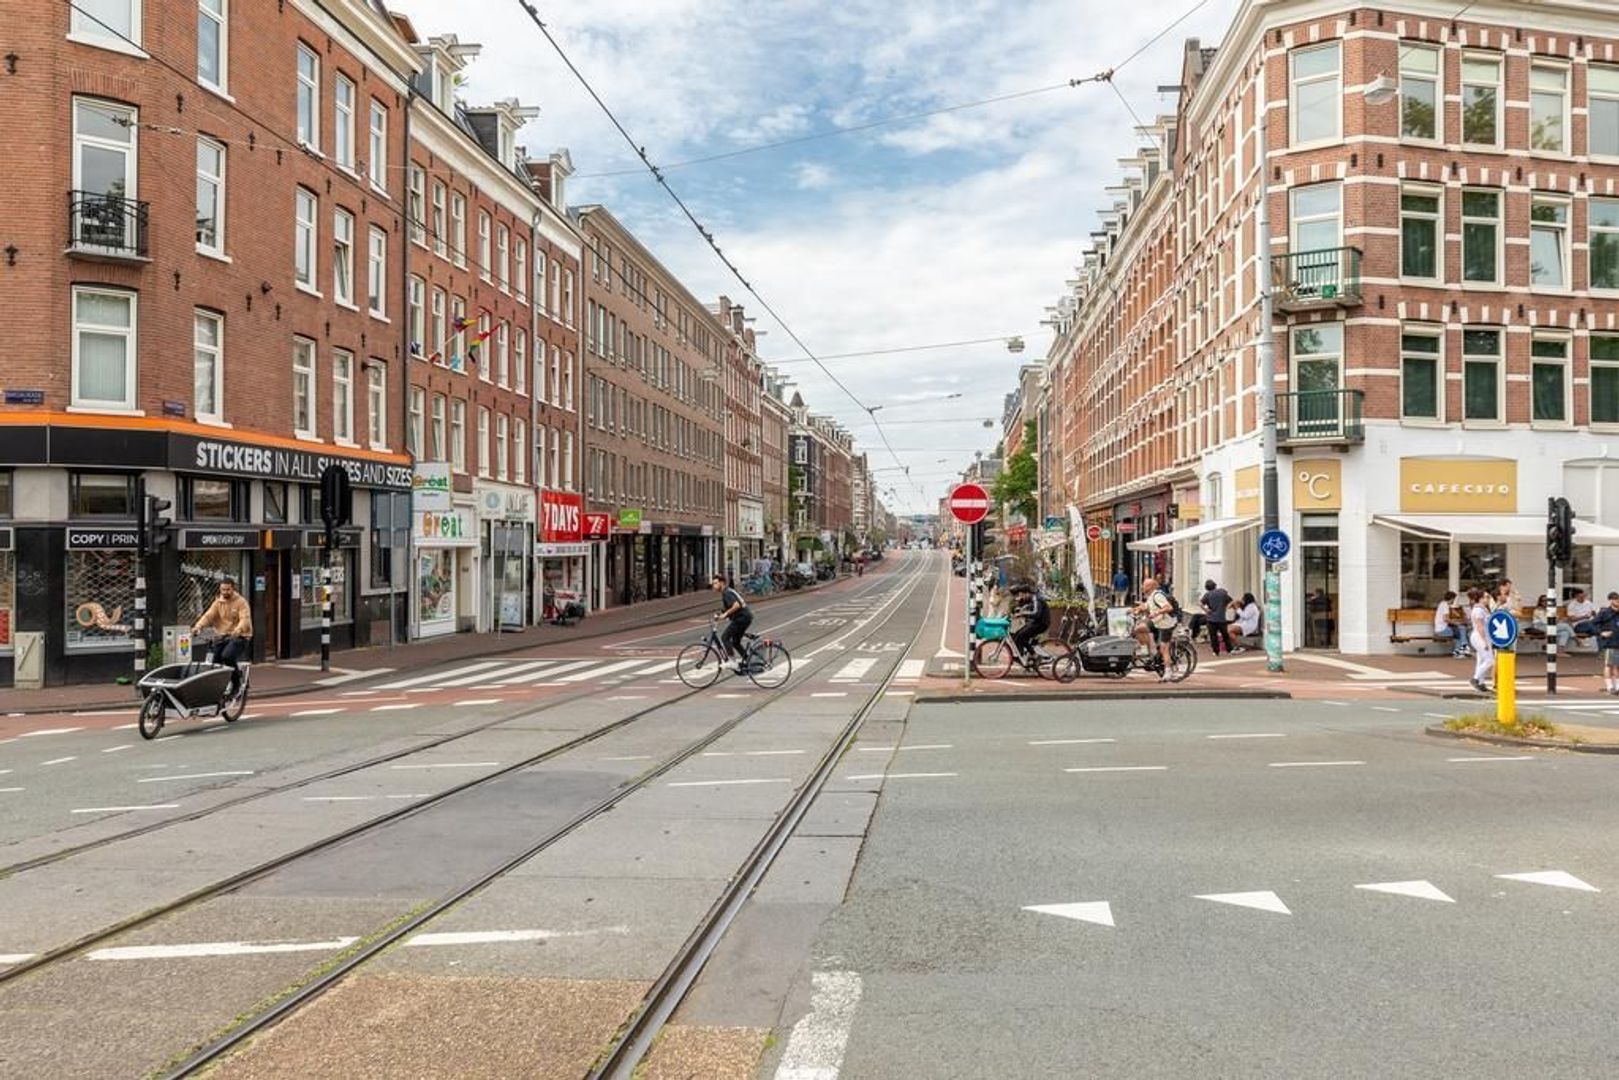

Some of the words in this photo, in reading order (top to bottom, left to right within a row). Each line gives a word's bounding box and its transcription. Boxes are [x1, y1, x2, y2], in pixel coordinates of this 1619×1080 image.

[196, 441, 272, 473] STICKERS
[275, 451, 289, 475] IN
[292, 454, 316, 478] ALL
[362, 462, 386, 484] AND
[386, 465, 412, 487] SIZES
[1410, 482, 1510, 495] CAFECITO
[543, 502, 551, 531] 7
[551, 503, 579, 532] DAYS
[71, 534, 104, 544] COPY
[112, 534, 139, 544] PRIN
[201, 535, 217, 544] OPEN
